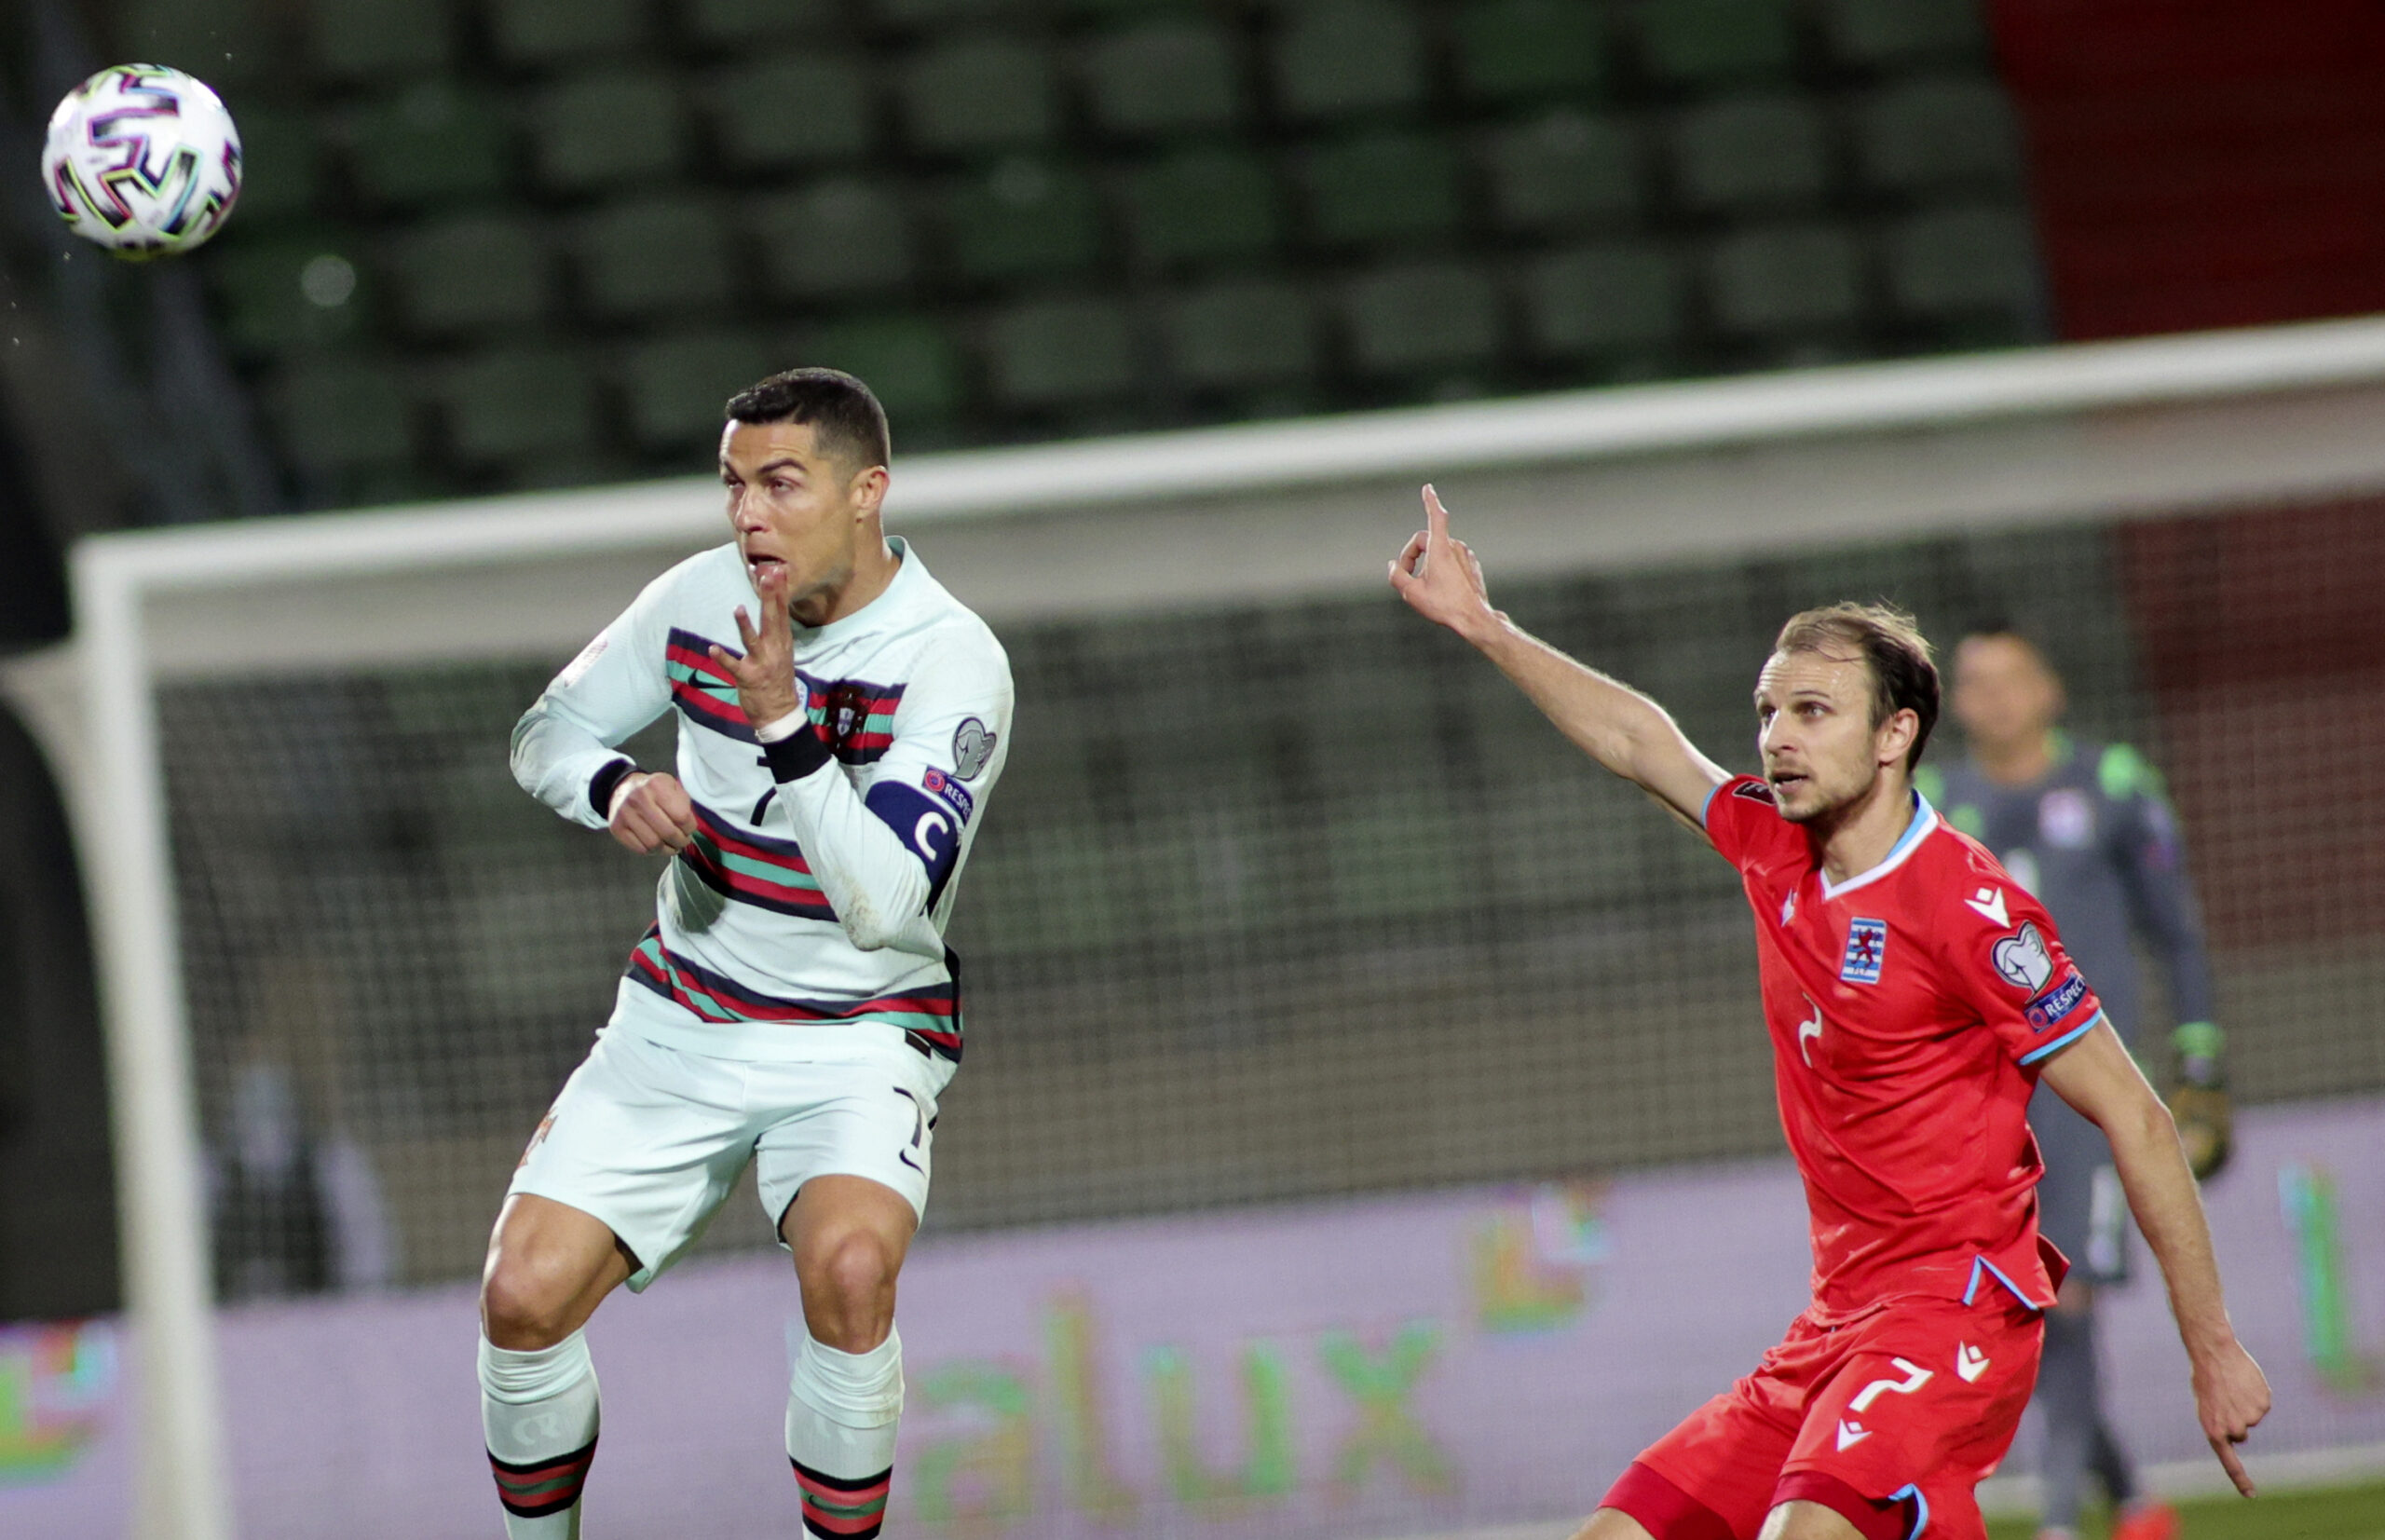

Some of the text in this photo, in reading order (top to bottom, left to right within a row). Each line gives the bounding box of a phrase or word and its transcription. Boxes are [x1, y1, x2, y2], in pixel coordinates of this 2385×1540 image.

[915, 811, 948, 862] C
[893, 1085, 922, 1149] 7
[1848, 1356, 1934, 1413] 7
